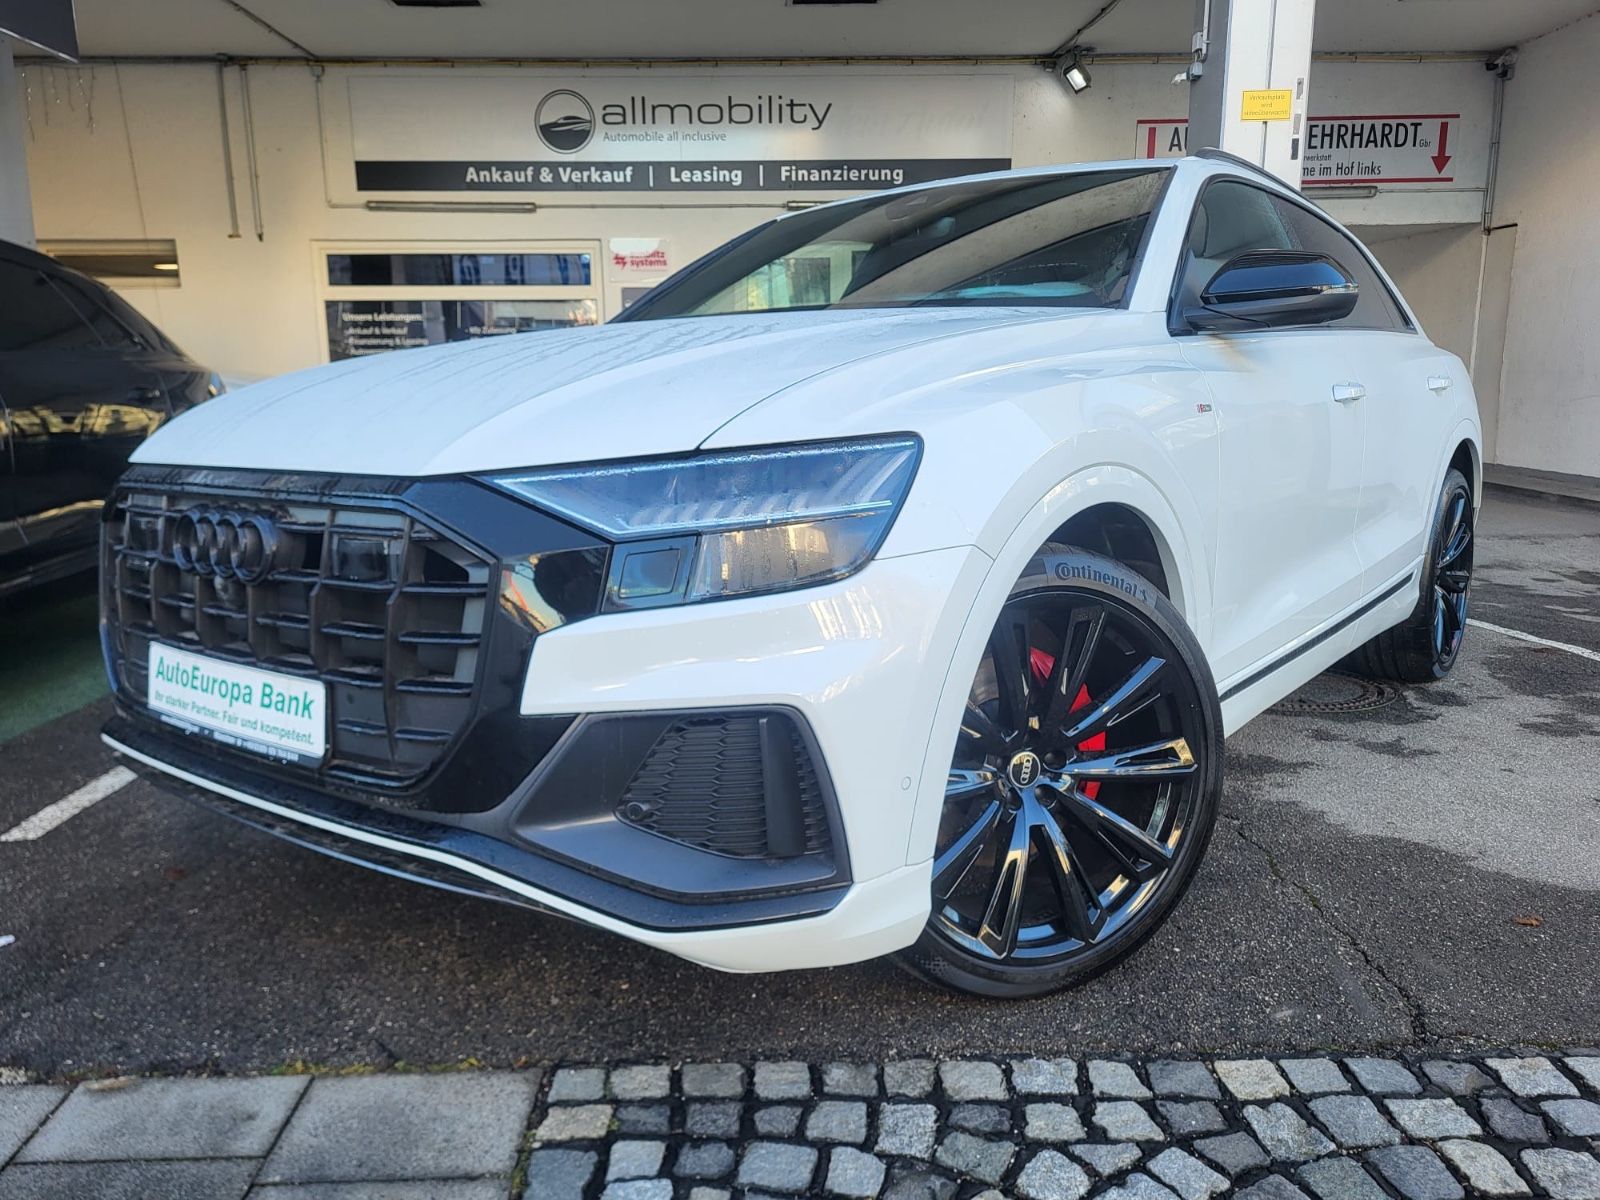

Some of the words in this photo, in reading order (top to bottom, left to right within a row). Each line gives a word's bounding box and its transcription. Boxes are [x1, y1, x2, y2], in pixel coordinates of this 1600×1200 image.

[602, 95, 832, 130] allmobility
[603, 131, 664, 143] Automobile
[667, 131, 679, 142] all
[681, 131, 727, 142] inclusive
[1307, 122, 1423, 150] EHRHARDT
[1419, 139, 1432, 148] Gbr
[465, 166, 534, 183] Ankauf
[539, 167, 553, 183] &
[558, 166, 633, 183] Verkauf
[670, 166, 742, 187] Leasing
[780, 164, 904, 185] Finanzierung
[1319, 163, 1332, 176] im
[1336, 162, 1355, 176] Hof
[1357, 161, 1382, 176] links
[630, 259, 667, 268] systems
[1055, 562, 1138, 597] Continental
[156, 656, 253, 708] AutoEuropa
[260, 682, 315, 719] Bank
[222, 710, 239, 725] Fair
[240, 716, 258, 730] und
